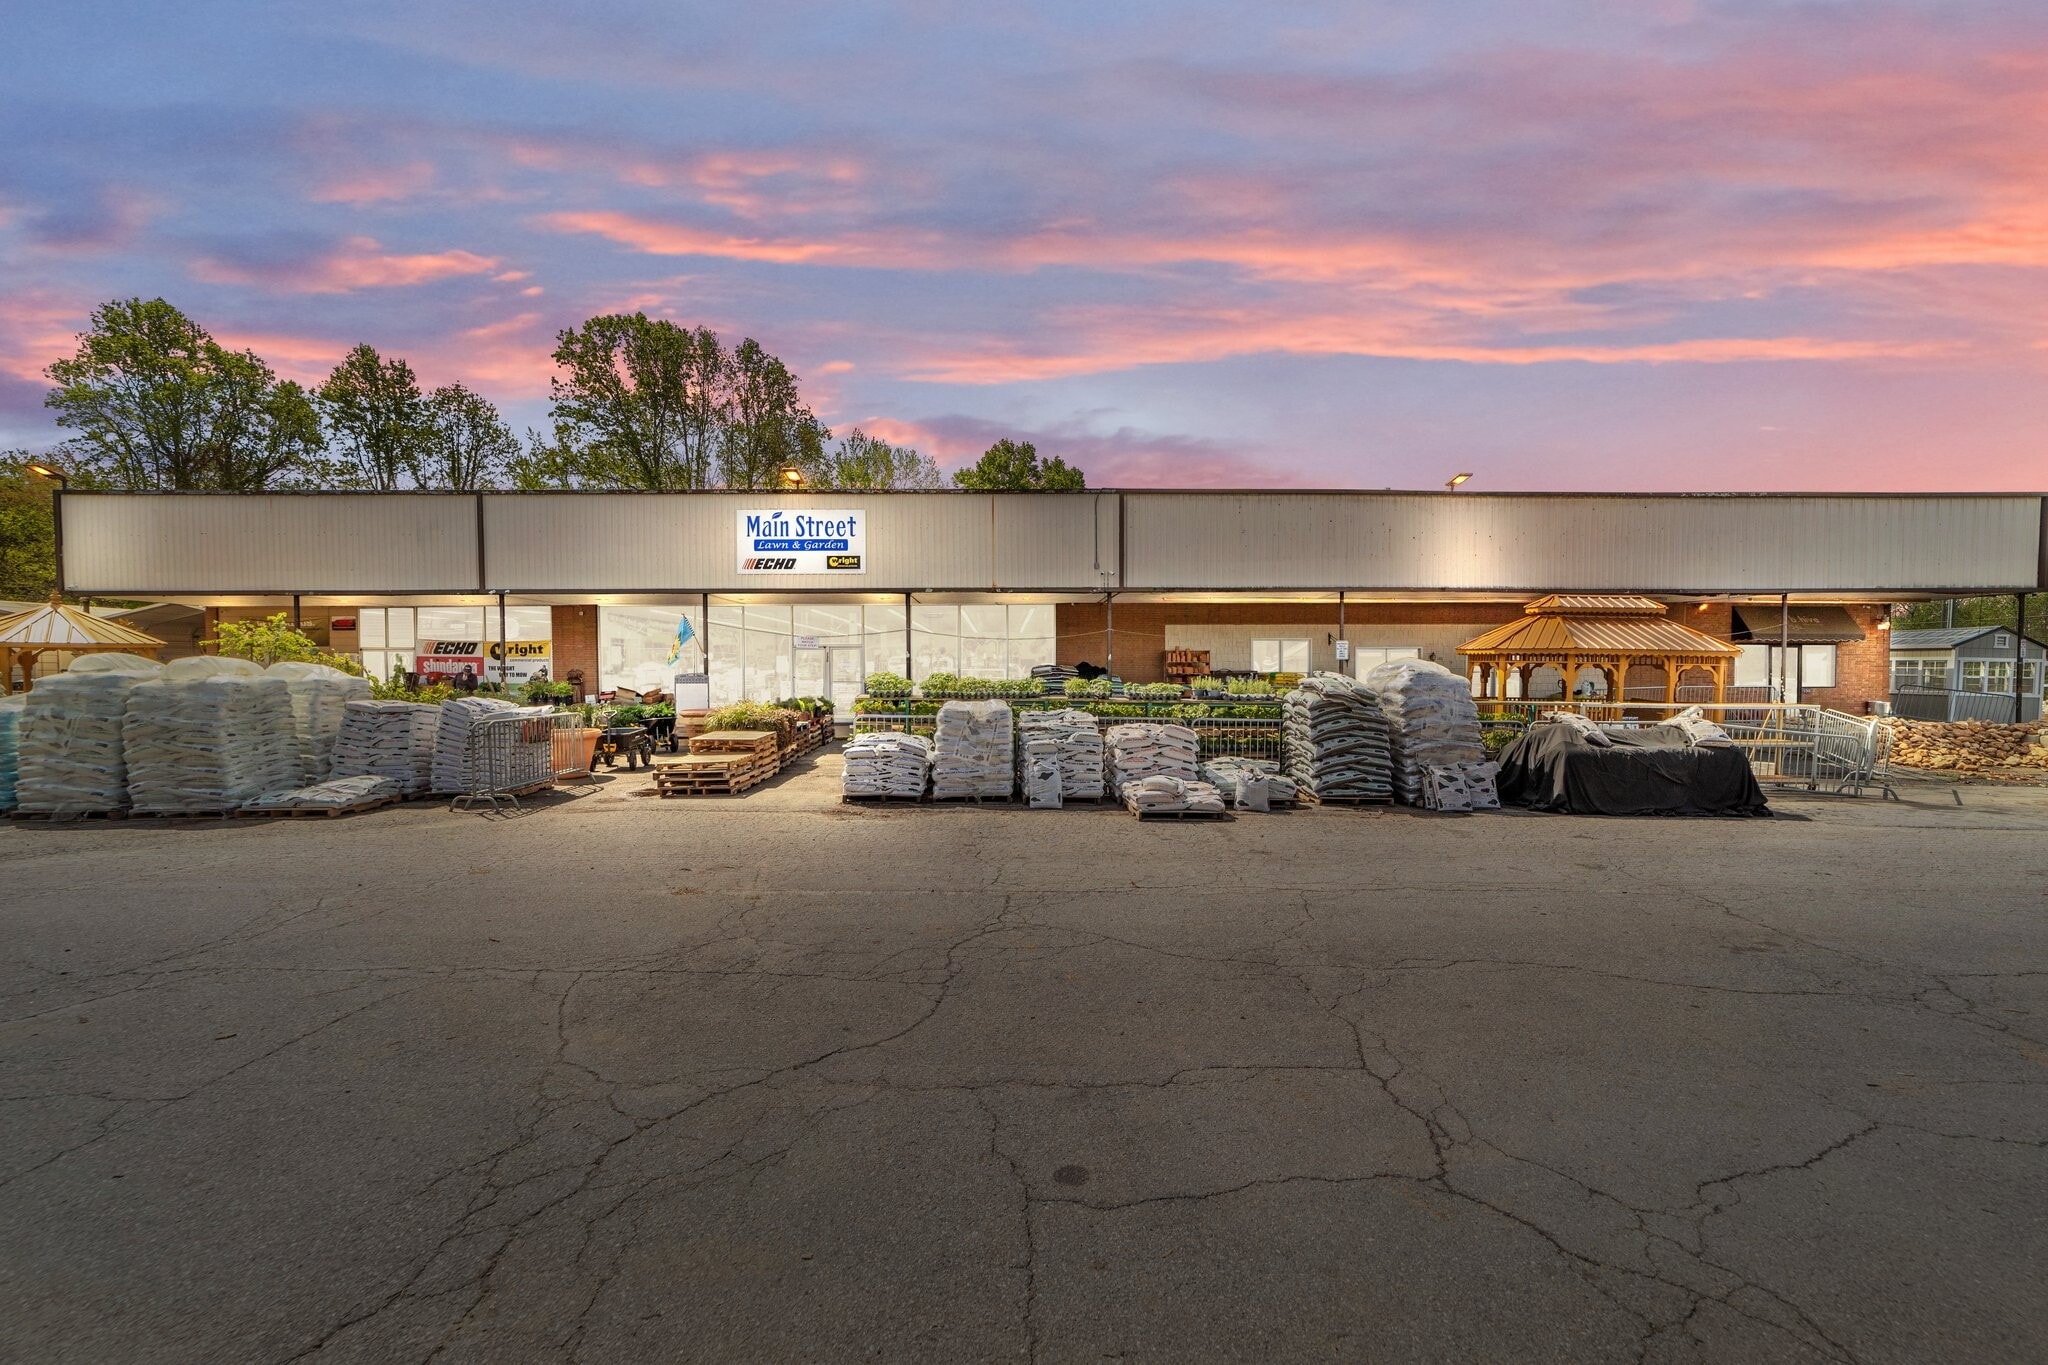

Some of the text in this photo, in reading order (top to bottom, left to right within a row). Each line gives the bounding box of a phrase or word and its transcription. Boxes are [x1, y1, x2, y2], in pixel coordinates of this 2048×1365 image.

[746, 512, 856, 537] Main Street
[757, 540, 844, 550] Lawn & Garden
[754, 558, 797, 570] ECHO
[433, 642, 478, 655] ECHO
